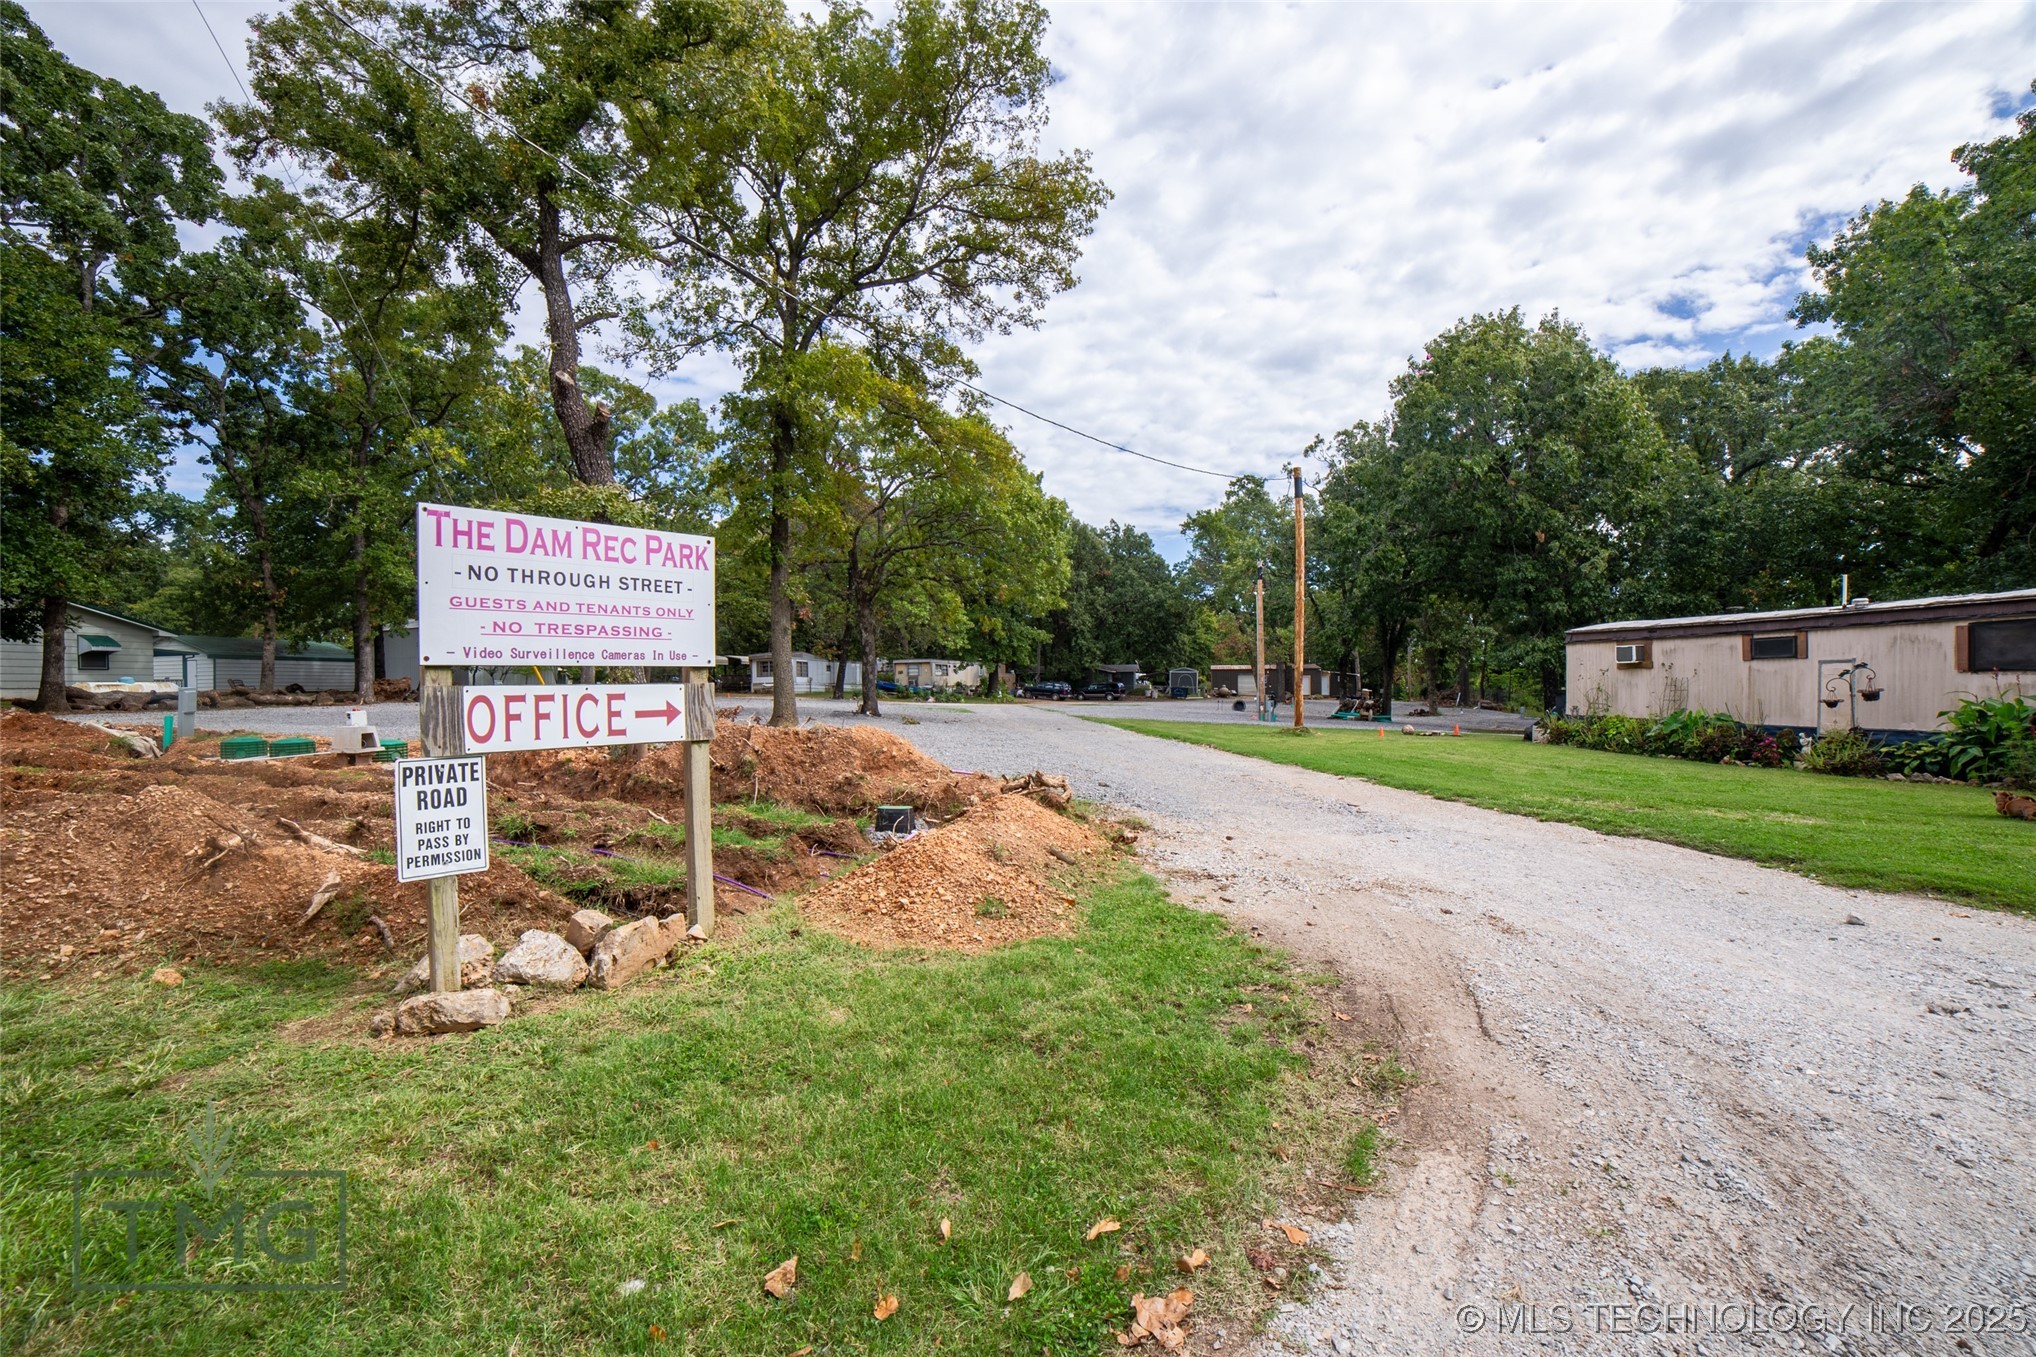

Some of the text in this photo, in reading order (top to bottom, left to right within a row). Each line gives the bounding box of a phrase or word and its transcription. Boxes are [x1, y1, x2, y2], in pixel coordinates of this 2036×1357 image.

[427, 509, 709, 571] THE DAM REC PARK
[507, 568, 610, 589] THROUGH
[618, 577, 683, 594] STREET
[449, 596, 694, 618] GUESTS AND TENANTS ONLY
[493, 621, 522, 633] NO
[535, 623, 662, 638] TRESPASSING
[463, 647, 503, 659] Video
[510, 648, 597, 660] Surveillence
[601, 650, 645, 660] Cameras
[652, 651, 664, 660] In
[669, 651, 687, 660] Use
[467, 693, 627, 744] OFFICE
[402, 762, 479, 787] PRIVATE
[417, 787, 467, 810] ROAD
[416, 817, 470, 834] RIGHT TO
[418, 834, 469, 851] PASS BY
[407, 848, 481, 869] PERMISSION
